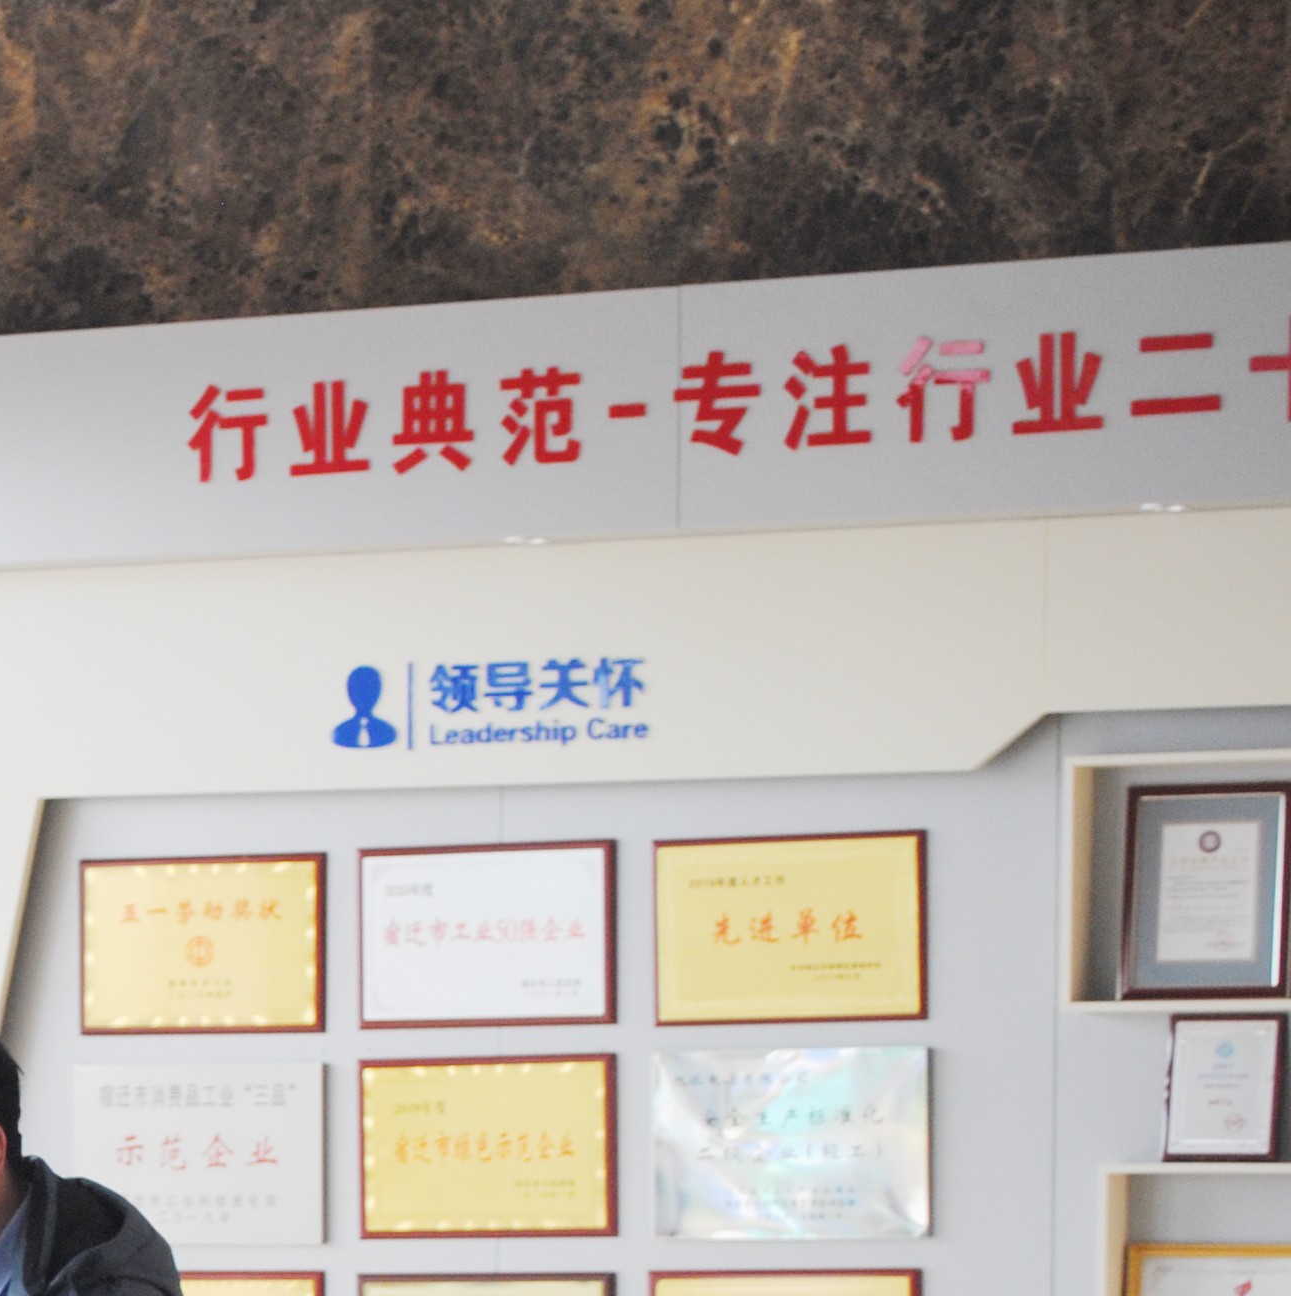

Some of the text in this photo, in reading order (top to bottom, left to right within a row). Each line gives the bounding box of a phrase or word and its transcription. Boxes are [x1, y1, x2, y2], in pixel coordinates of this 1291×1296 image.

[429, 657, 645, 713] 领导关怀
[430, 717, 649, 745] Leadership Care
[713, 908, 863, 946] 先进单位
[115, 1131, 279, 1171] 示范企业
